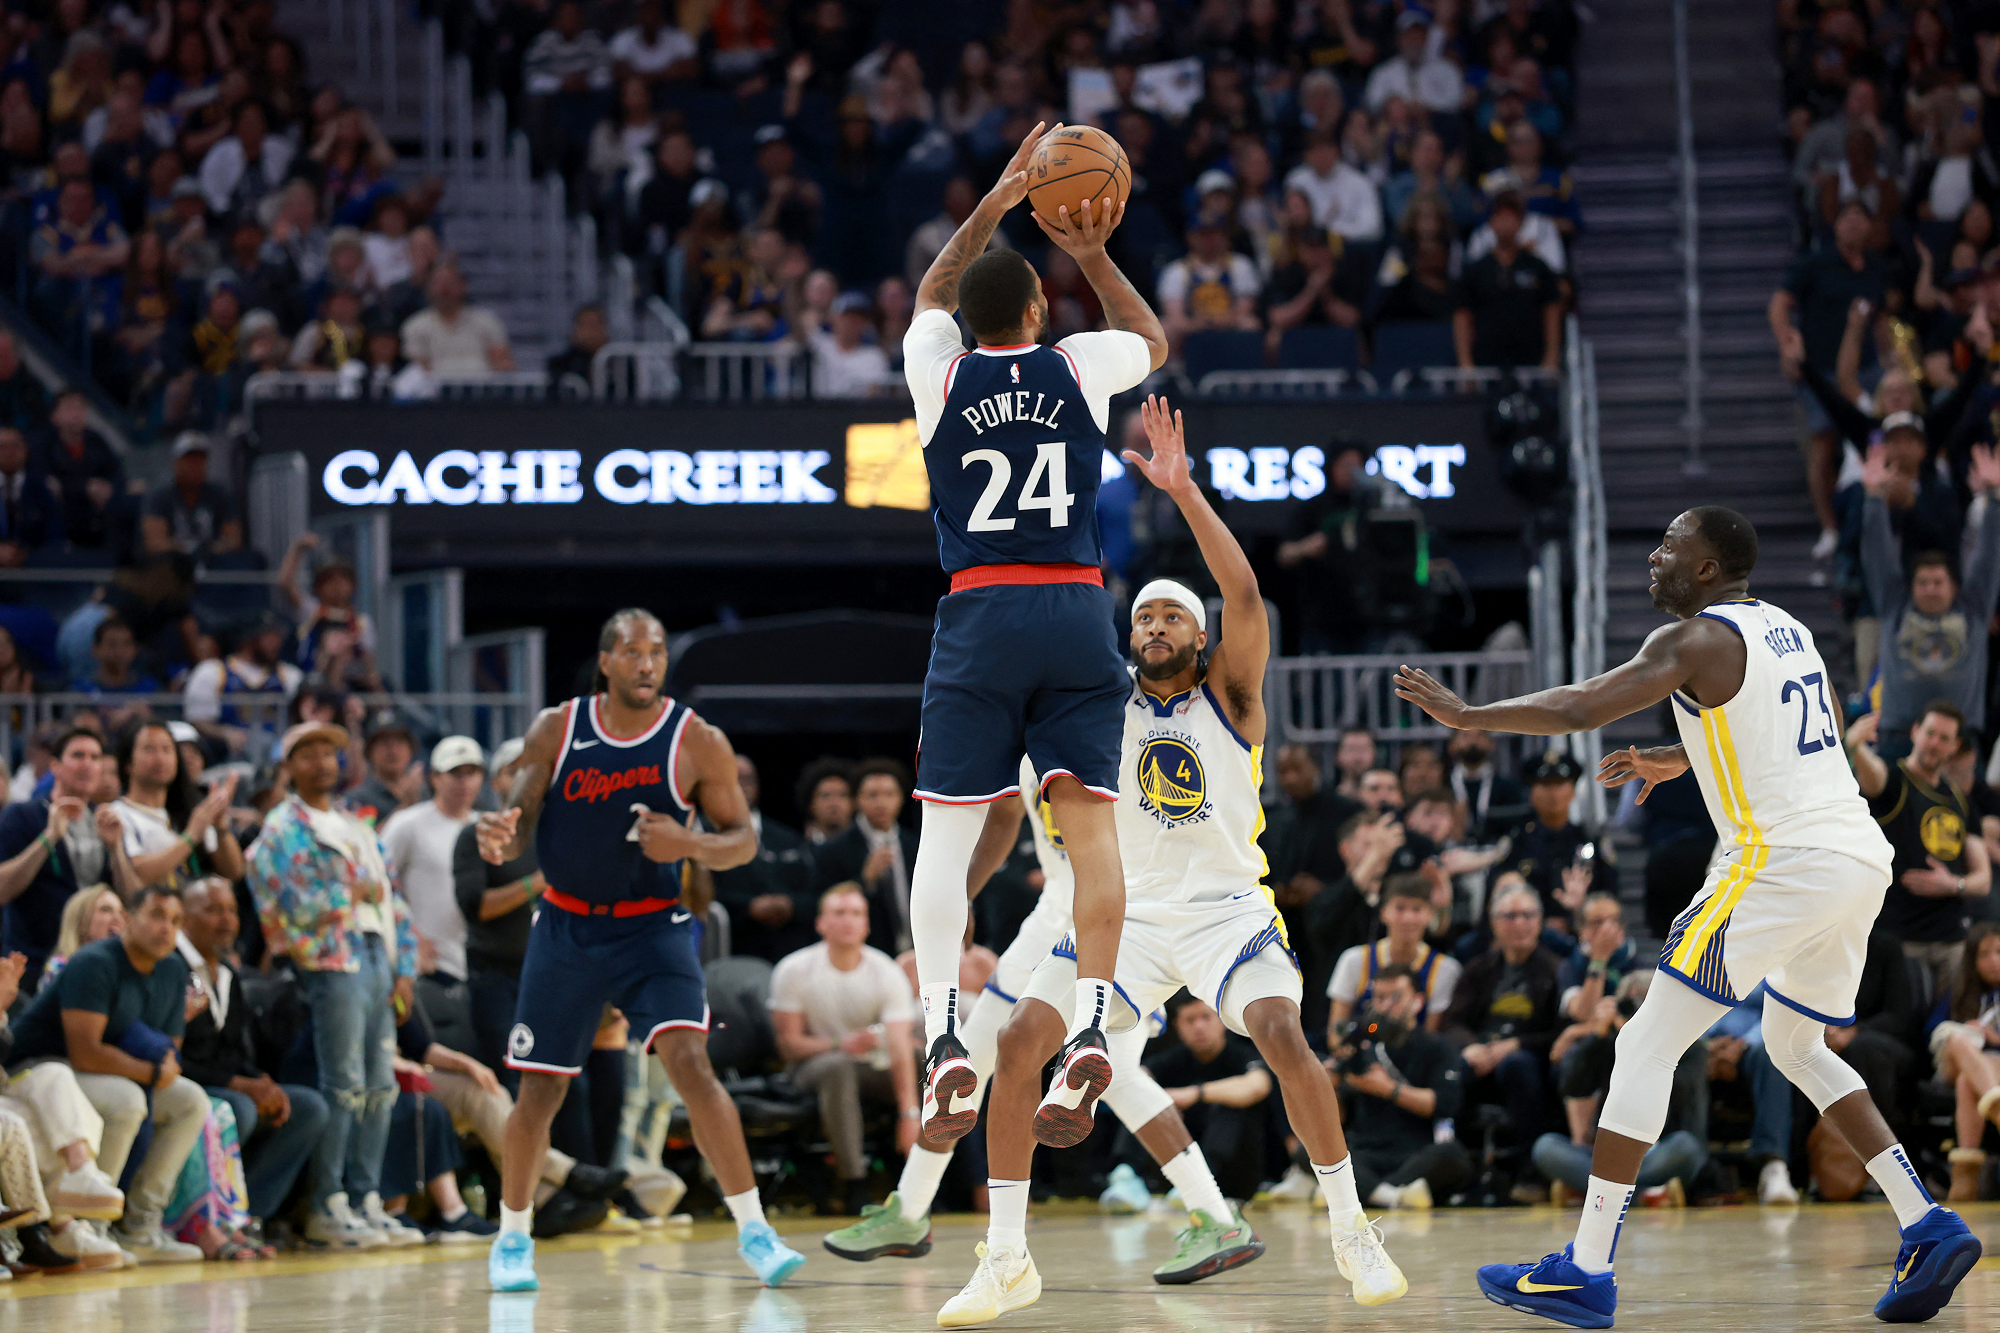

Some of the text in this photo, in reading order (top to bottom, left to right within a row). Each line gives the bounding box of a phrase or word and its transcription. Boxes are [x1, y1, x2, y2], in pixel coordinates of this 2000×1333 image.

[961, 390, 1065, 436] POWELL
[322, 449, 584, 506] CACHE
[593, 448, 837, 505] CREEK
[1205, 445, 1467, 501] RESRT
[961, 441, 1076, 533] 24
[1764, 627, 1805, 659] GREEN
[1781, 671, 1837, 757] 23
[1172, 730, 1202, 751] STATE
[563, 764, 662, 804] Clippers
[1176, 759, 1191, 783] 4
[1138, 796, 1214, 830] WARRIORS
